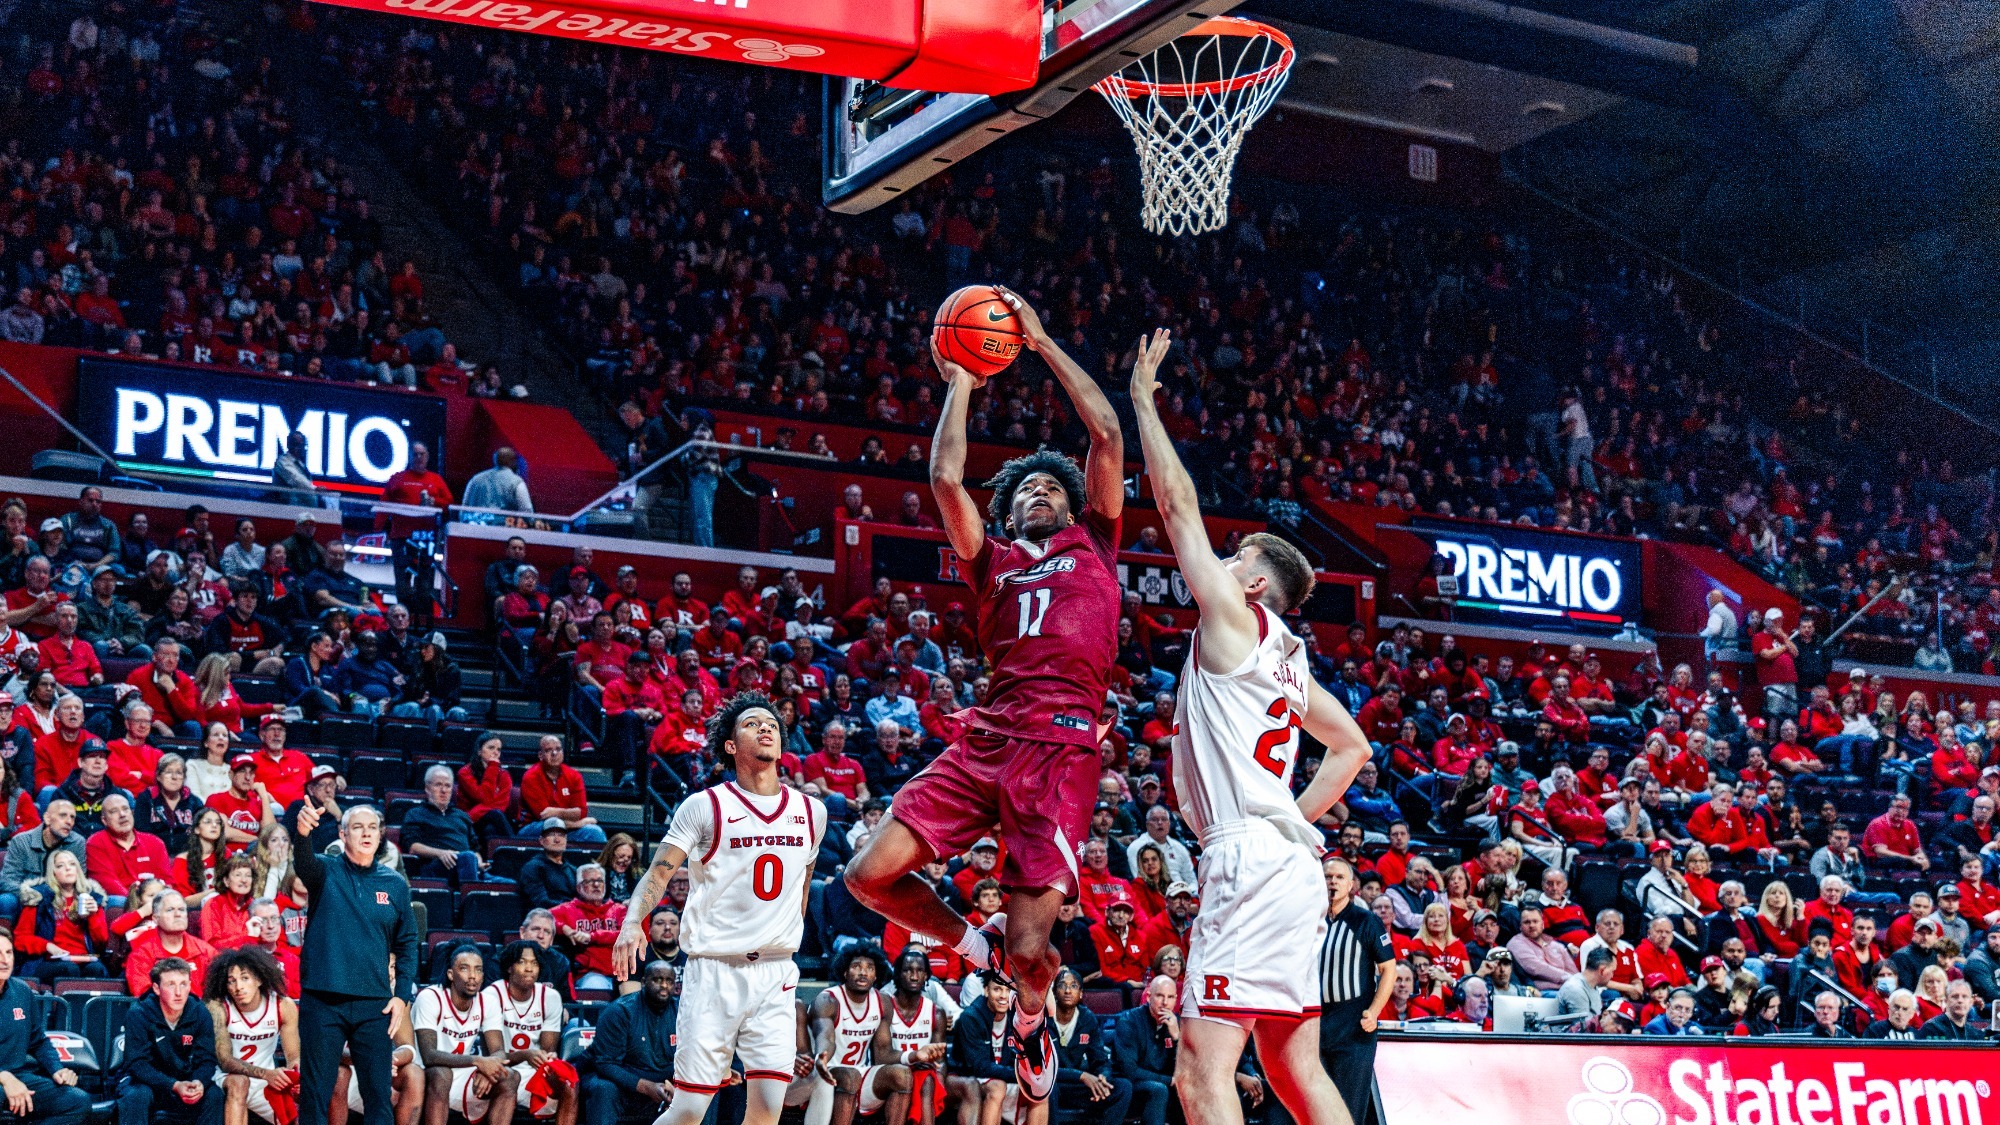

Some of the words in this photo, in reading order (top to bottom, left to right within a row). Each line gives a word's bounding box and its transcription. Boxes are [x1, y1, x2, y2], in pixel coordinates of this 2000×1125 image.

[194, 344, 212, 363] R
[114, 387, 409, 484] PREMIO
[1436, 540, 1621, 612] PREMIO
[678, 609, 694, 625] R
[1017, 587, 1052, 640] 11
[802, 673, 818, 688] R
[730, 835, 804, 849] RUTGERS
[753, 853, 784, 901] 0
[376, 891, 390, 905] R
[1203, 974, 1231, 1001] R
[229, 1031, 275, 1041] RUTGERS
[891, 1032, 929, 1040] RUTGERS
[841, 1041, 869, 1066] 21
[1668, 1058, 1983, 1125] StateFarm
